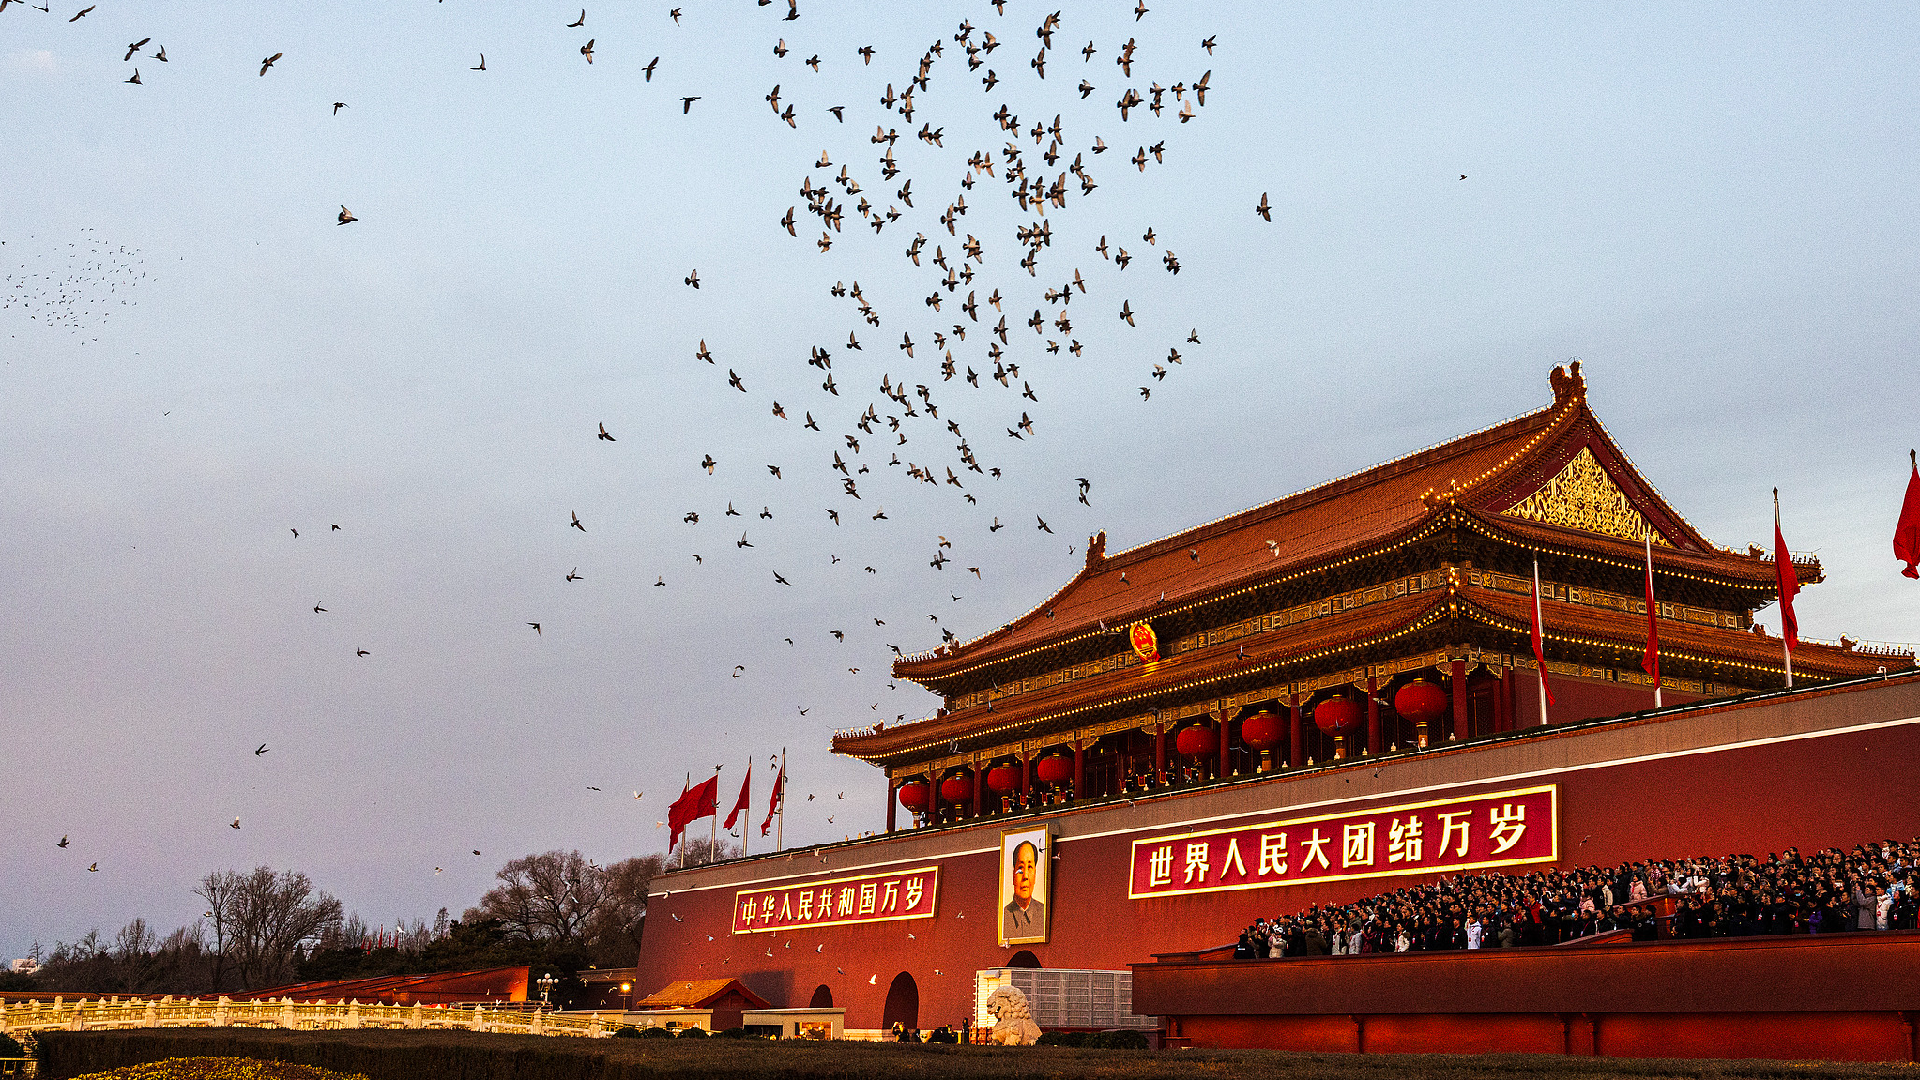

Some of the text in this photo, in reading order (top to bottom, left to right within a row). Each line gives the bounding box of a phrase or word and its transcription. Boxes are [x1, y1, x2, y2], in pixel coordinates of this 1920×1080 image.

[1149, 804, 1527, 887] 世界人民大团结万岁
[742, 877, 924, 926] 中华人民共和国万岁
